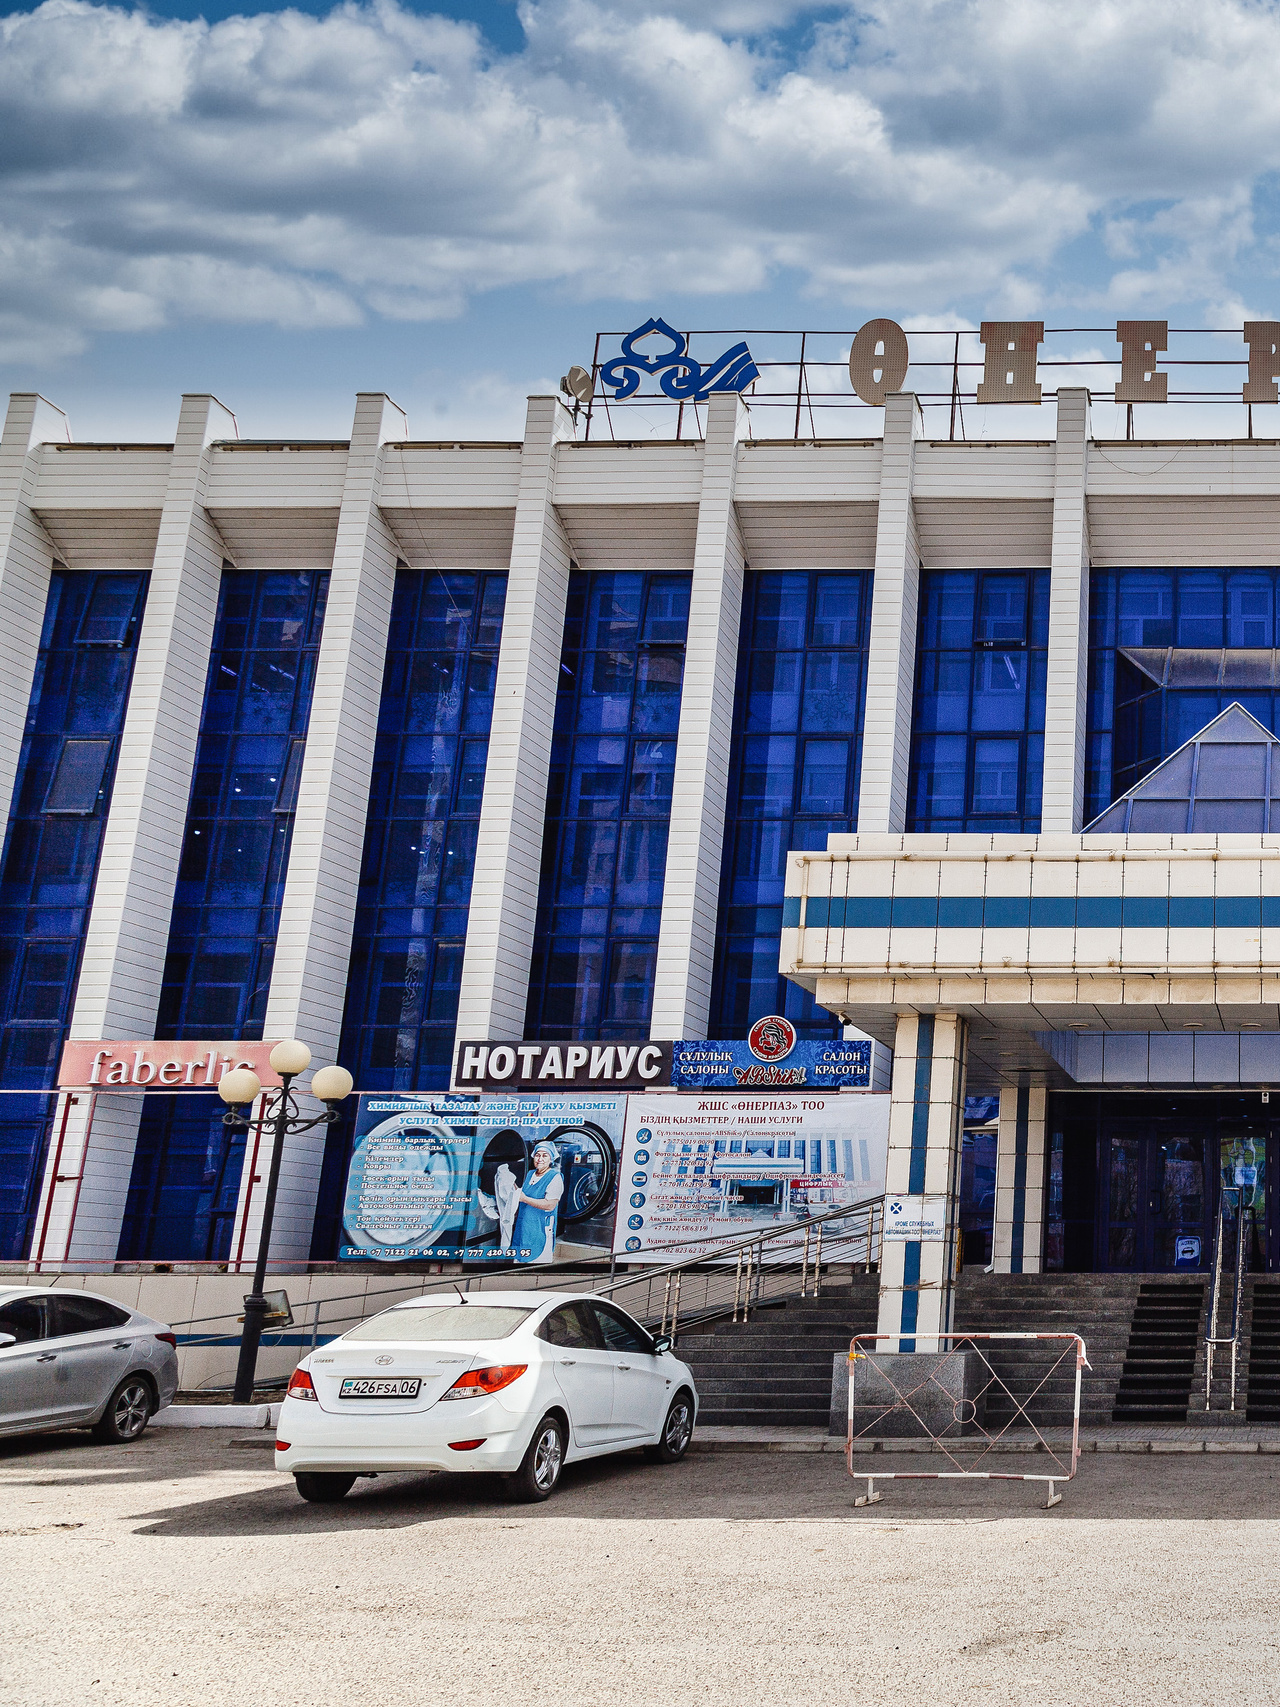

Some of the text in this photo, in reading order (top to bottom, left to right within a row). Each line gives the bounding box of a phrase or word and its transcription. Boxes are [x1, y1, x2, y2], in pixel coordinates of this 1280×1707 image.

[679, 1052, 733, 1063] СҰЛУЛЫҚ
[822, 1052, 861, 1062] САЛОН
[462, 1045, 663, 1080] НОТАРИУС
[680, 1065, 729, 1075] САЛОНЫ
[815, 1065, 867, 1075] КРАСОТЫ
[369, 1102, 617, 1112] ХИМИЯЛЫҚ ТАЗАЛАУ ЖӘНЕ КІР ЖУУ ҚЫЗМЕТІ
[698, 1101, 825, 1111] ЖШС «ӨНЕРПАЗ» ТОО
[399, 1114, 585, 1125] УСЛУГИ ХИМЧИСТКИ И ПРАЧЕЧНОЙ
[640, 1116, 804, 1125] БІЗДІҢ ҚЫЗМЕТТЕР НАШИ УСЛУГИ
[346, 1248, 531, 1257] Тел: +7 7122 21 06 02, +7 777 420 53 95
[401, 1381, 416, 1393] 06
